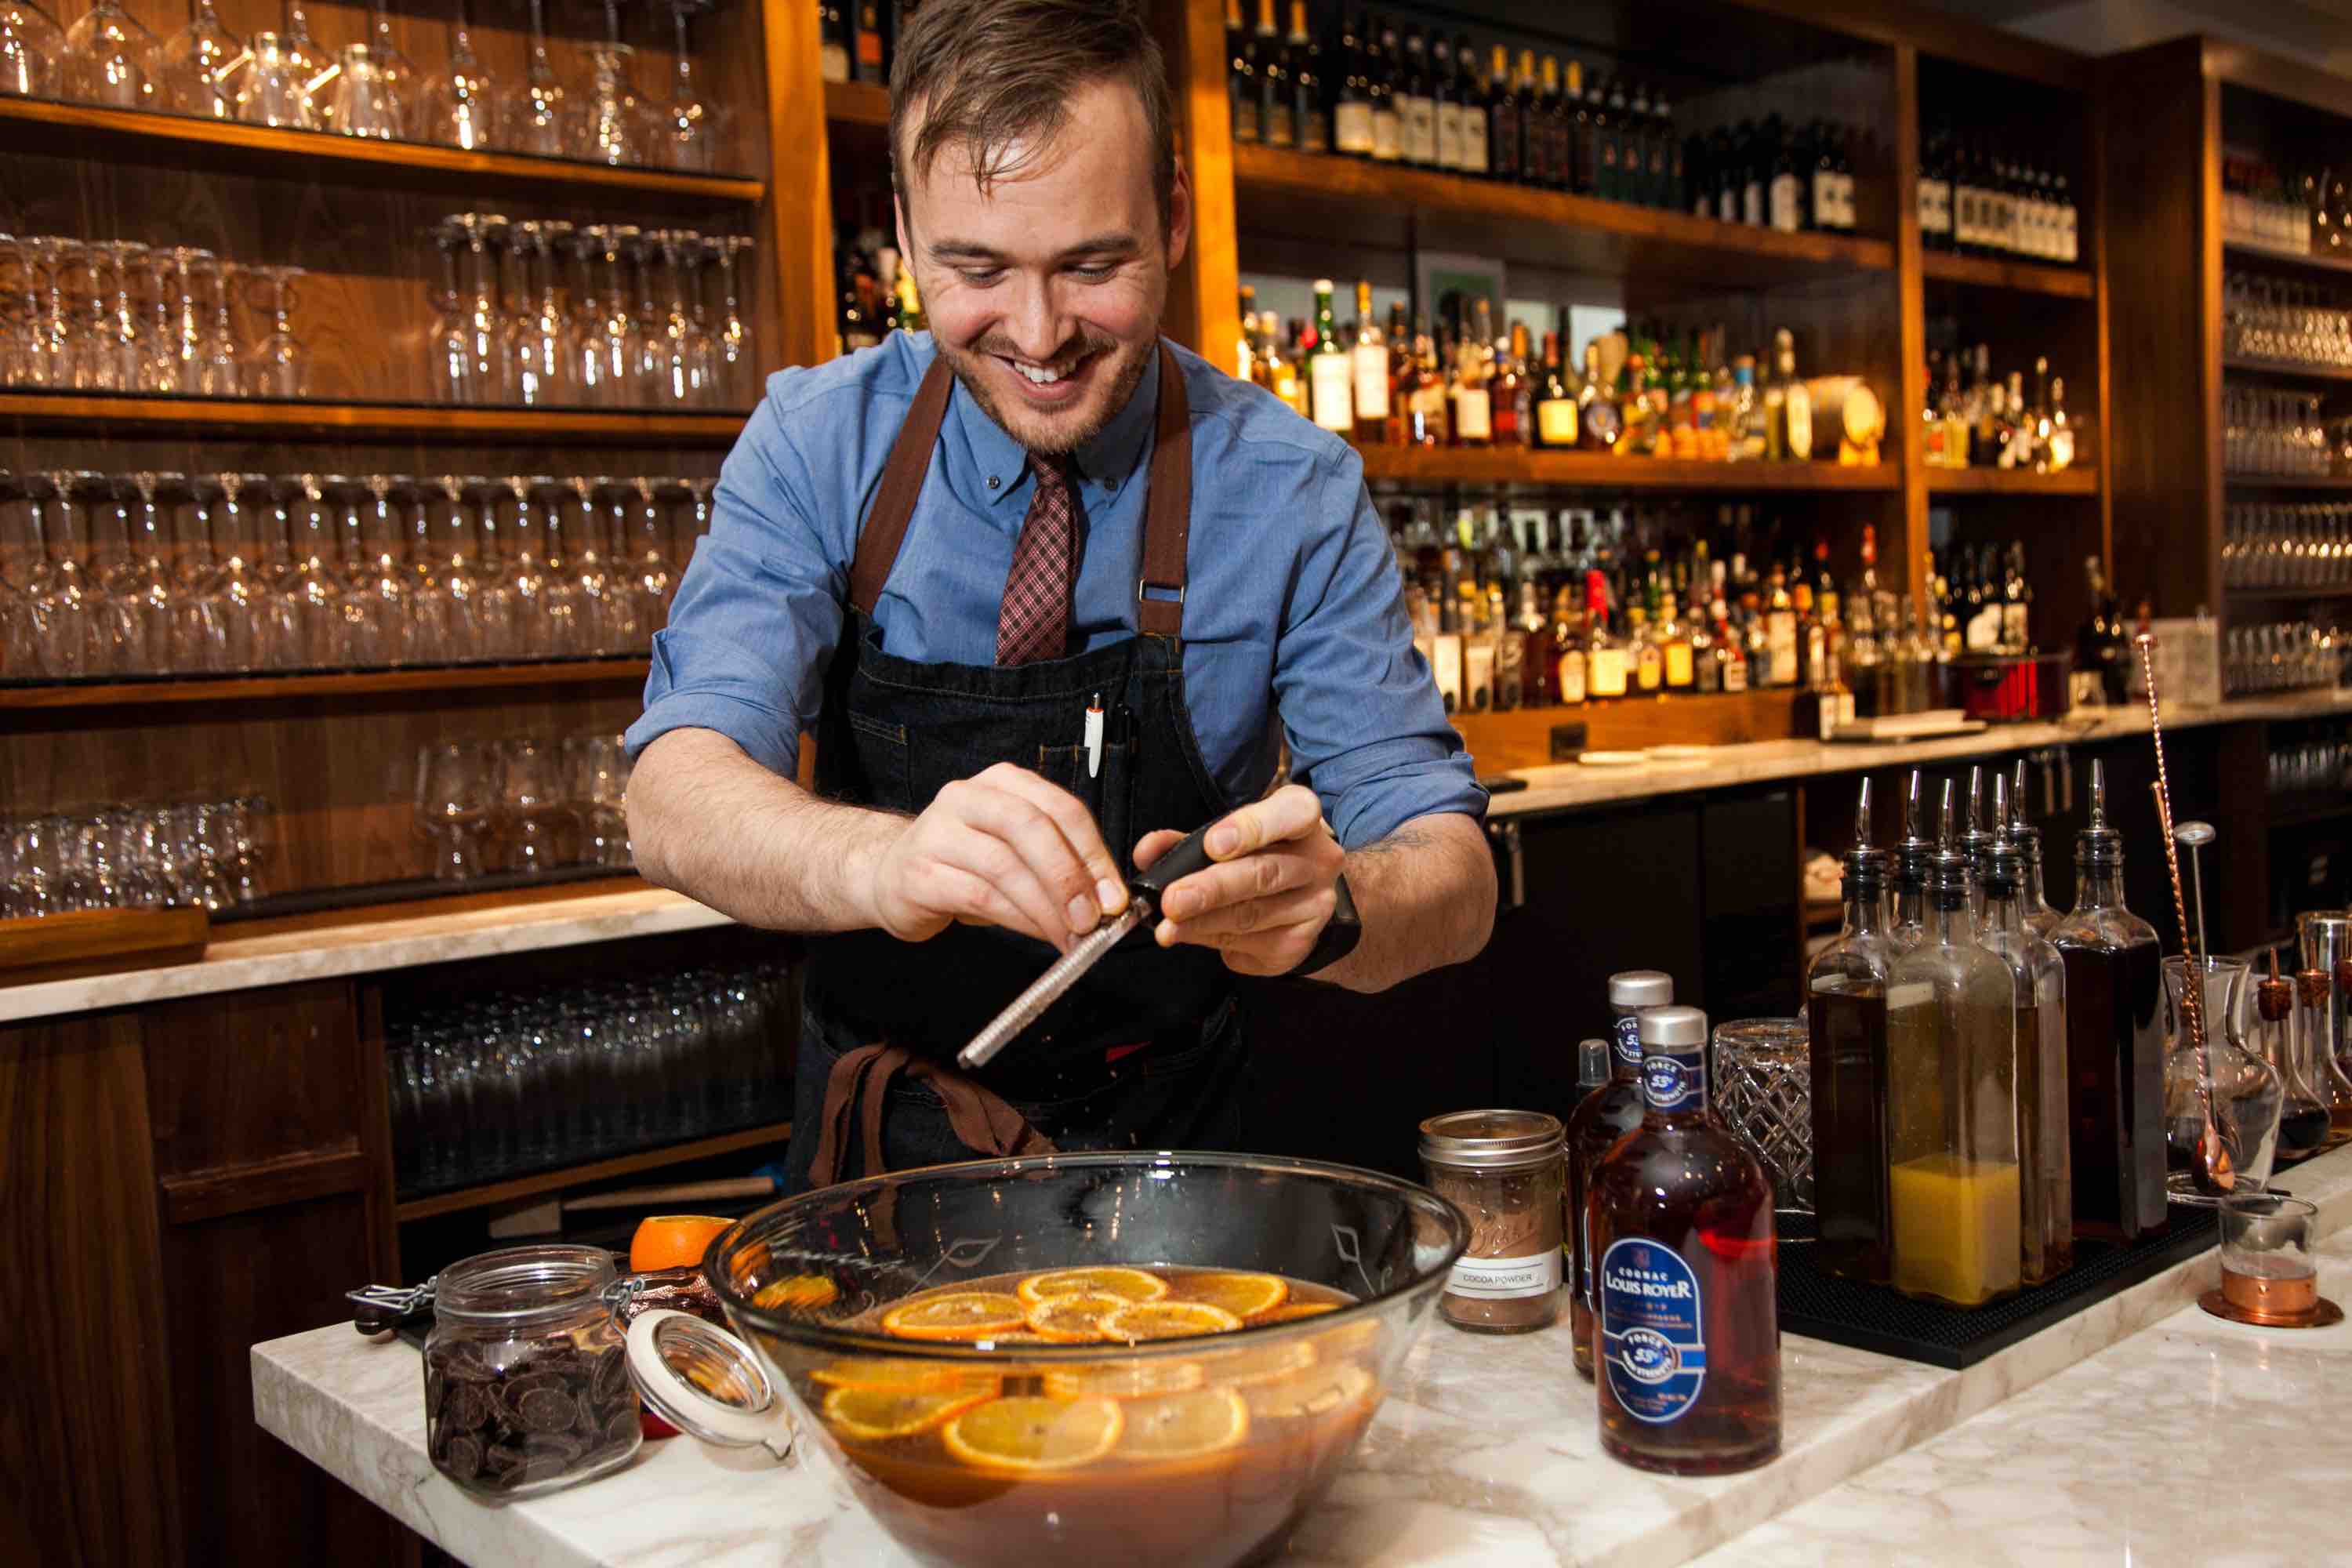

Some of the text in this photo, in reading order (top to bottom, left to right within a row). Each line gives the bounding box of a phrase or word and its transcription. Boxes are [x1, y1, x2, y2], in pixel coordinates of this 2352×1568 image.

[1646, 1062, 1677, 1073] FORCE
[1463, 1273, 1532, 1284] COCOA POWDER
[1618, 1266, 1668, 1281] COGNAC
[1628, 1334, 1664, 1349] FORCE
